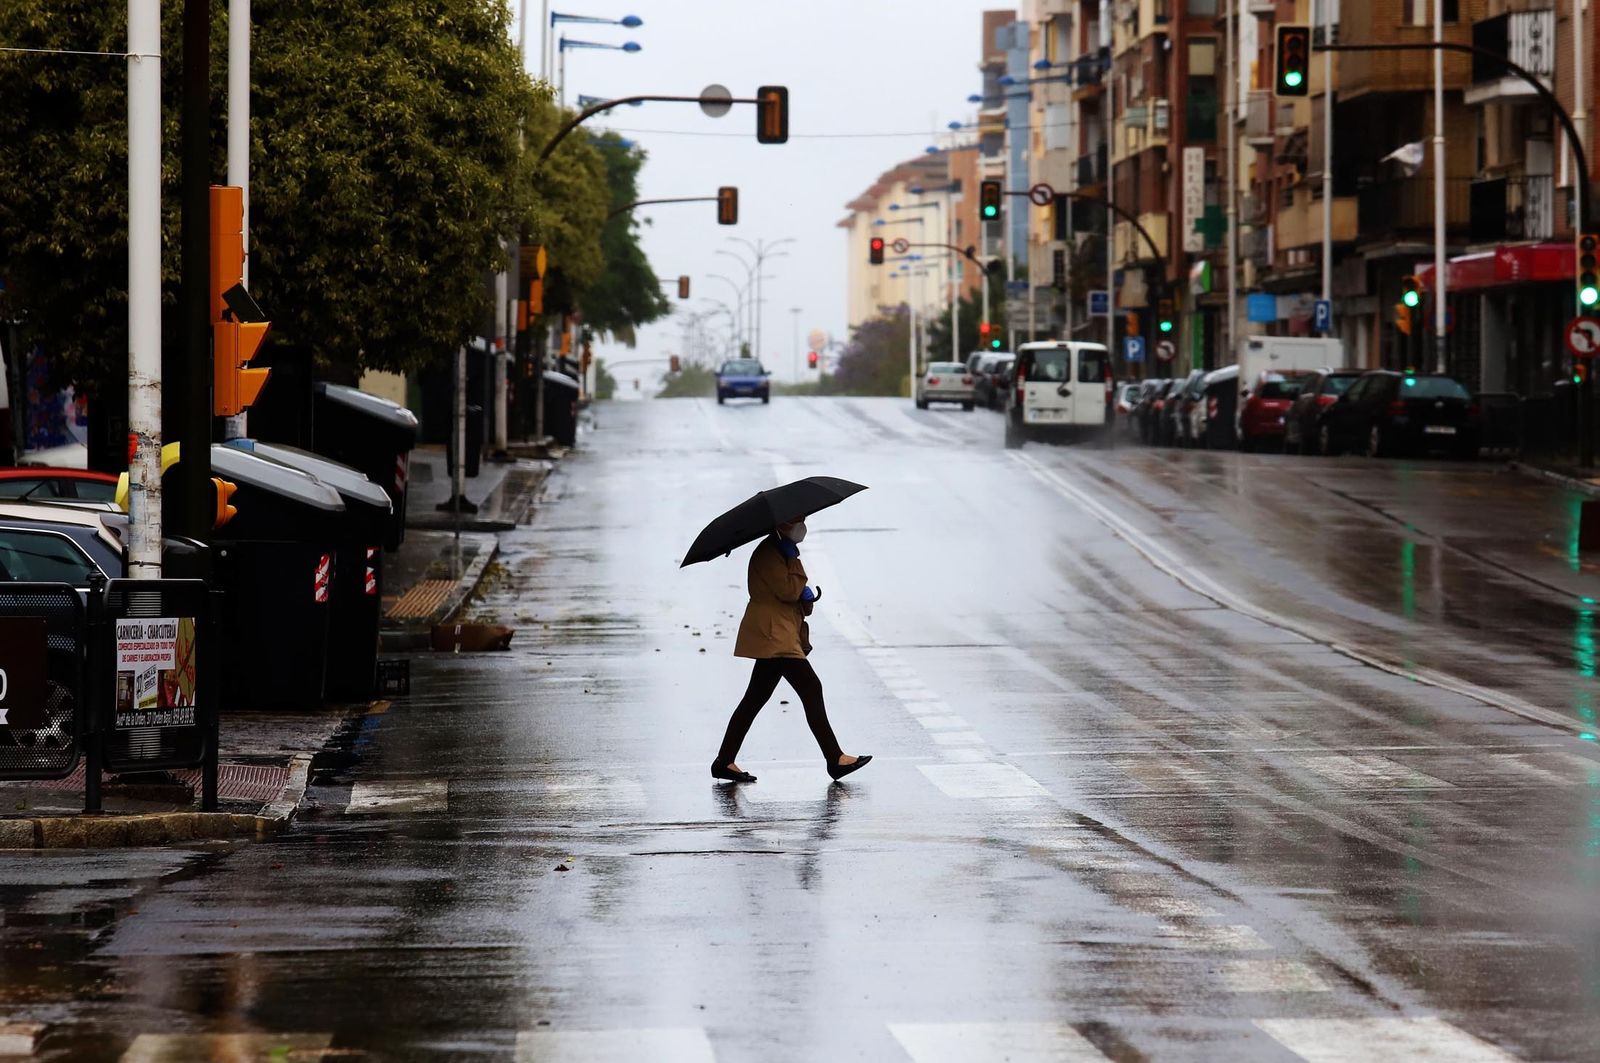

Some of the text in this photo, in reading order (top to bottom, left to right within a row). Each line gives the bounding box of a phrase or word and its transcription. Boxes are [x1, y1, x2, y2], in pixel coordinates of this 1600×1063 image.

[1316, 303, 1327, 328] P
[1126, 340, 1140, 358] P
[117, 620, 143, 639] CARNICERÍA
[147, 620, 176, 639] CHARCUTERÍA
